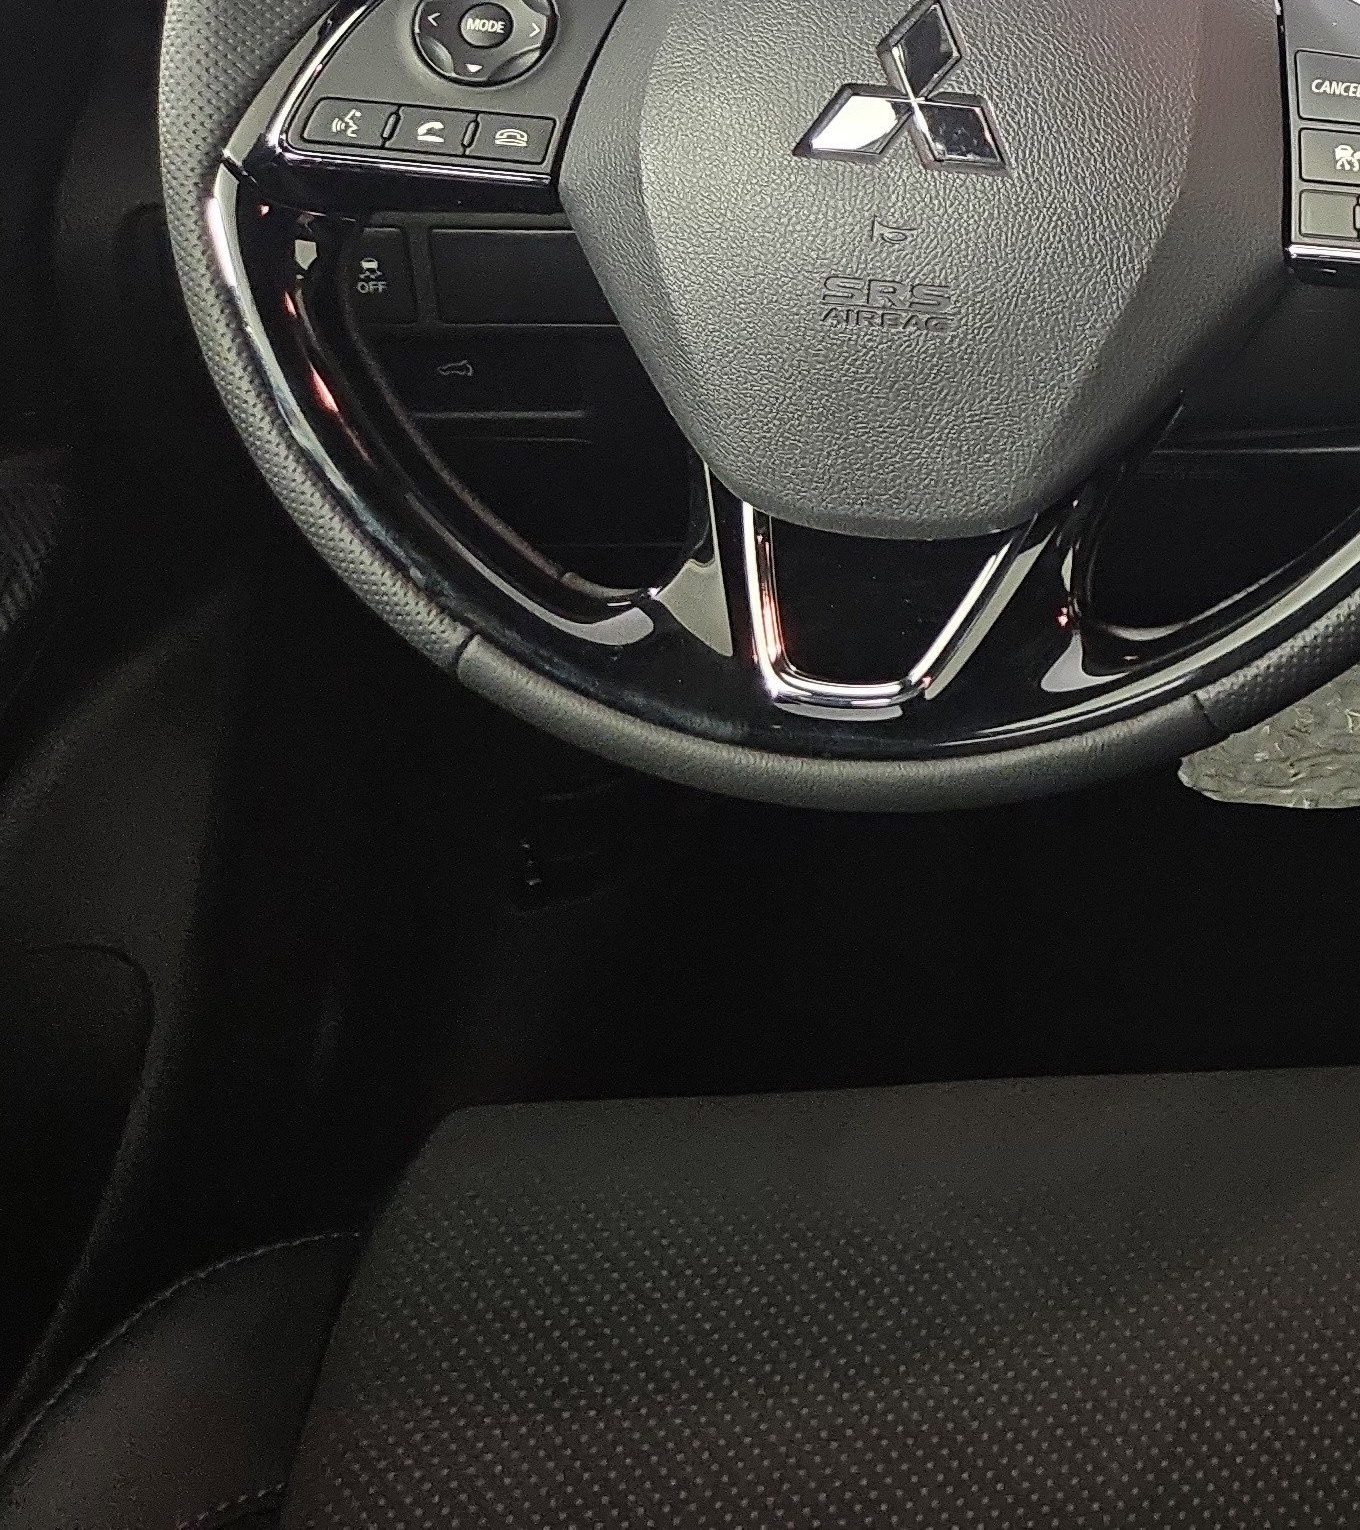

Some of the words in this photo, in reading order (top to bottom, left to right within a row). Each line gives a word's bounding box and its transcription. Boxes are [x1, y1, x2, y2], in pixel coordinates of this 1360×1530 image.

[466, 17, 505, 33] MODE
[356, 281, 388, 294] OFF
[822, 276, 951, 312] SRS
[822, 308, 953, 332] AIRBAG
